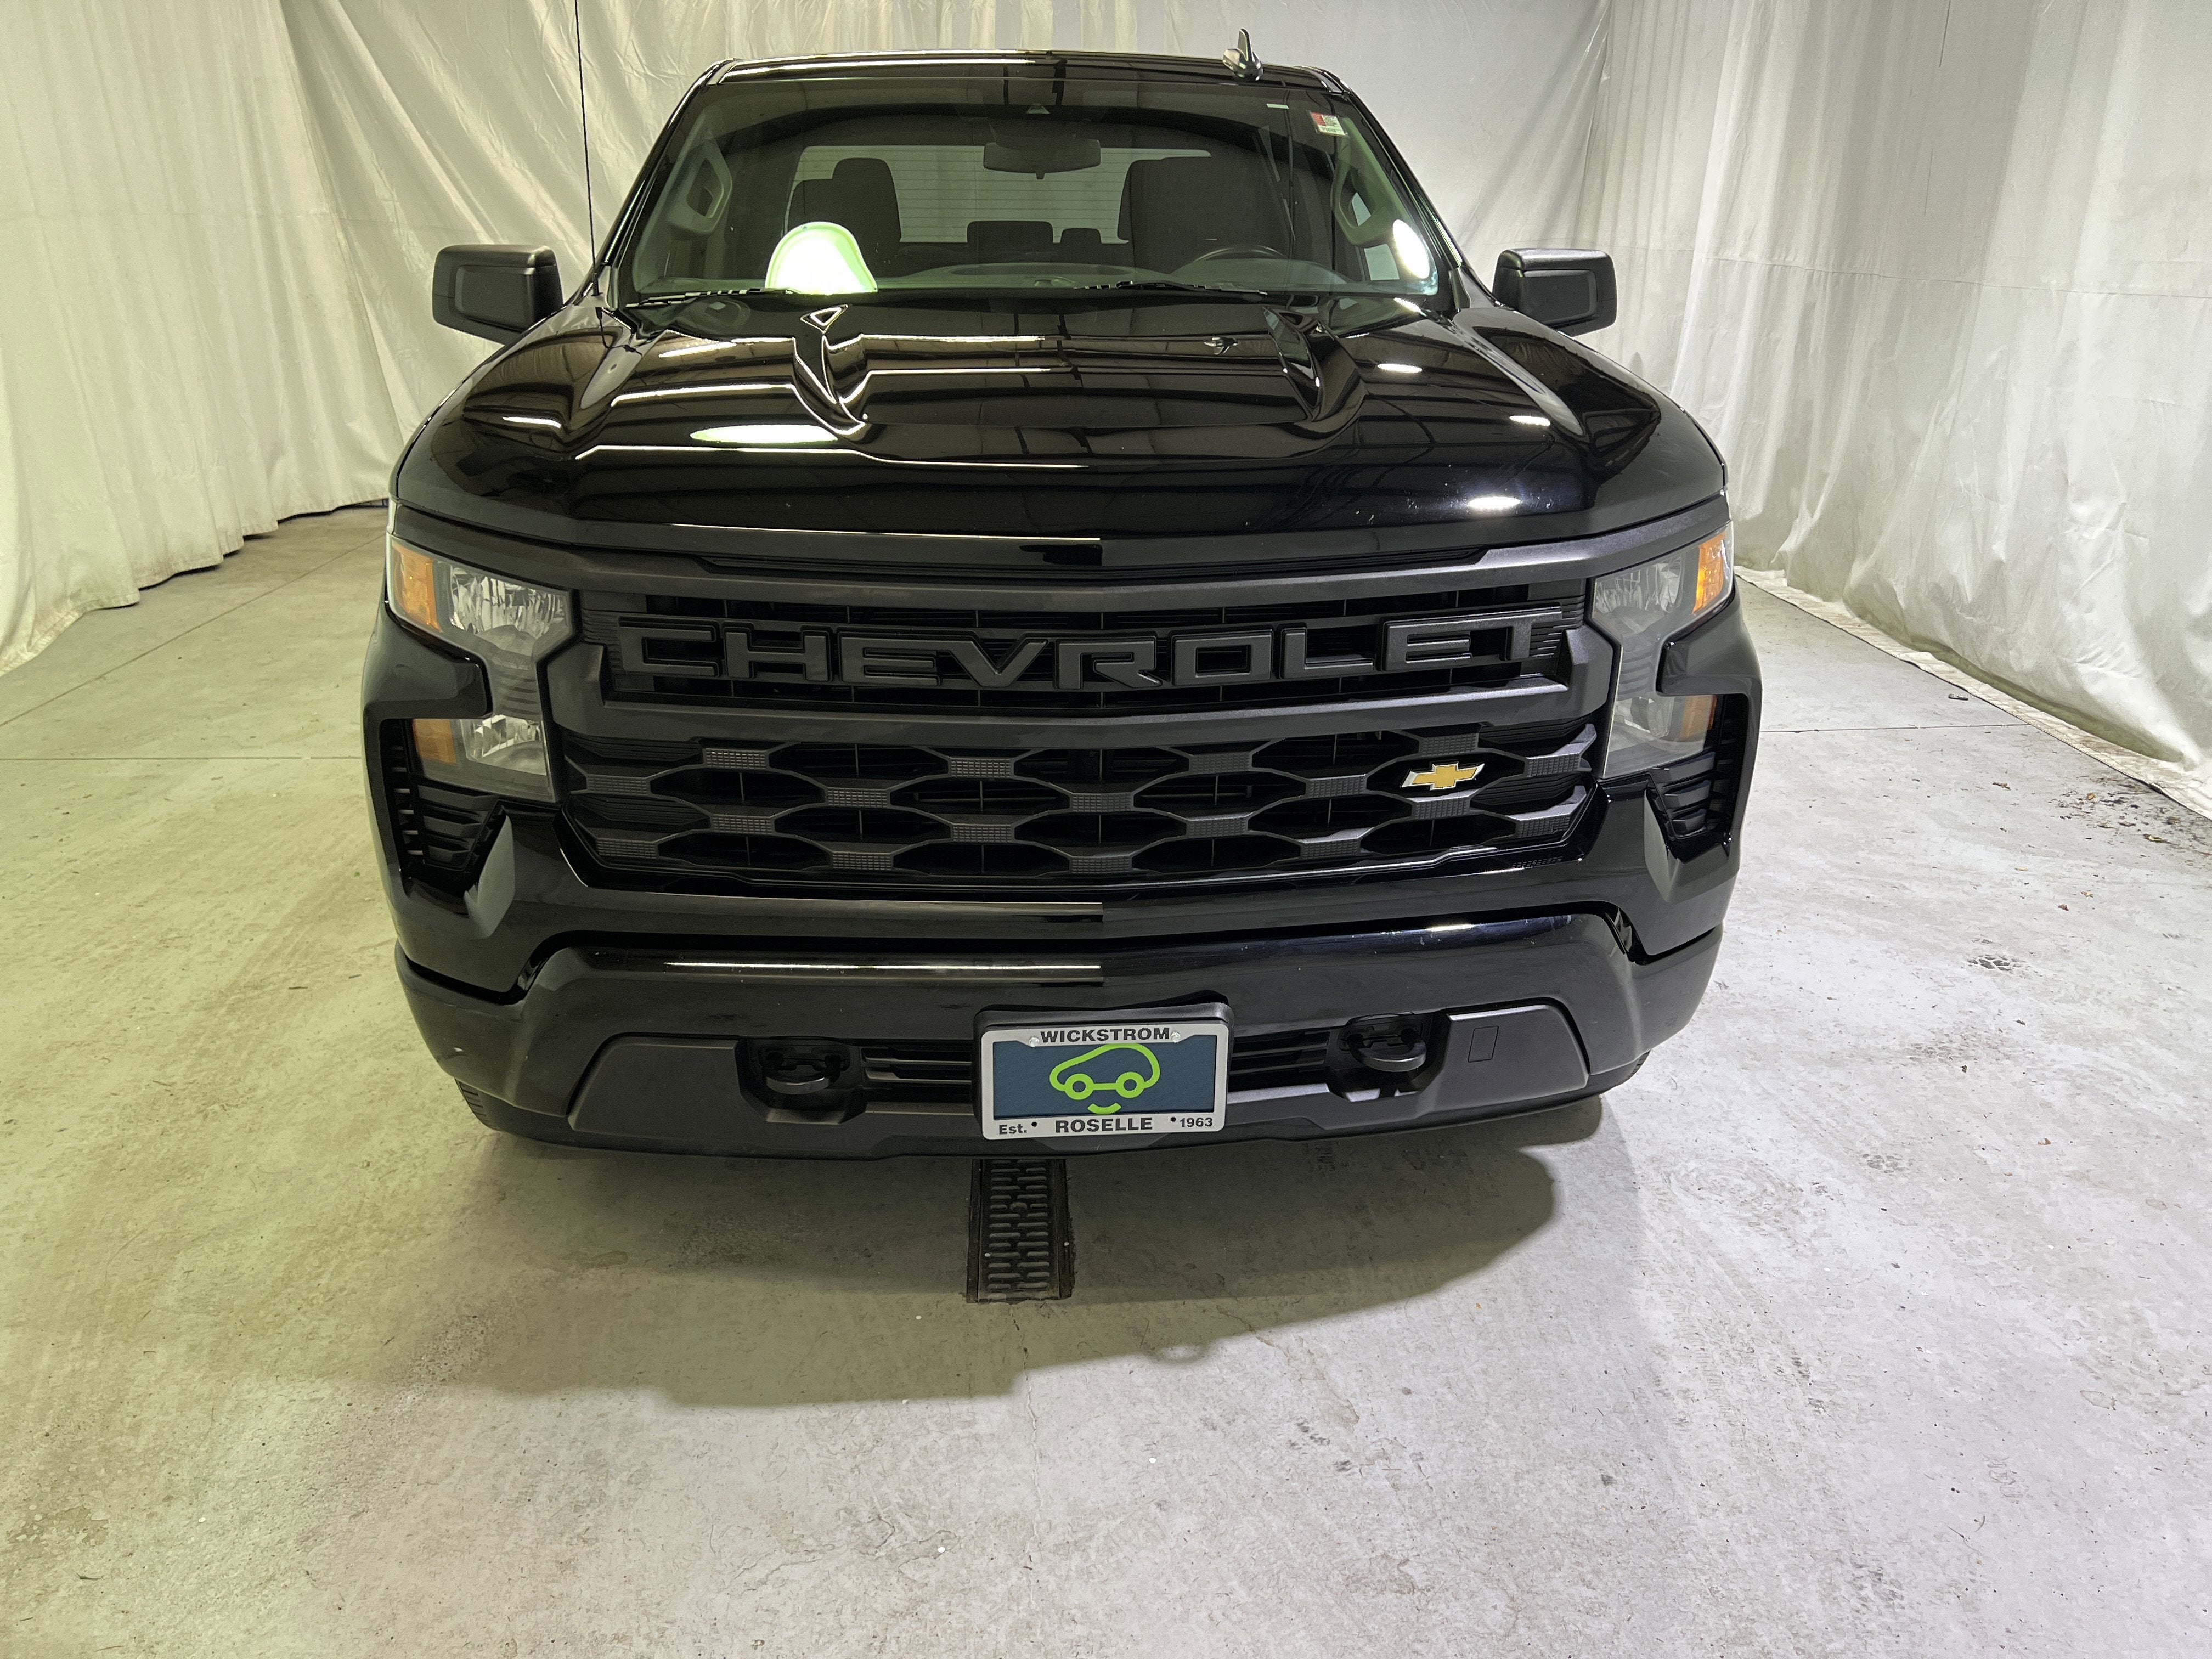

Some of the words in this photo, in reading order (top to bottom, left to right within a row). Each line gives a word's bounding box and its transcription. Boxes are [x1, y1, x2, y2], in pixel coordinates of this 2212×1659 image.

[618, 605, 1564, 690] CHEVROLET
[1040, 1027, 1170, 1043] WICKSTROM
[998, 1124, 1028, 1135] Est.
[1055, 1116, 1153, 1133] ROSELLE
[1180, 1116, 1213, 1128] 1963
